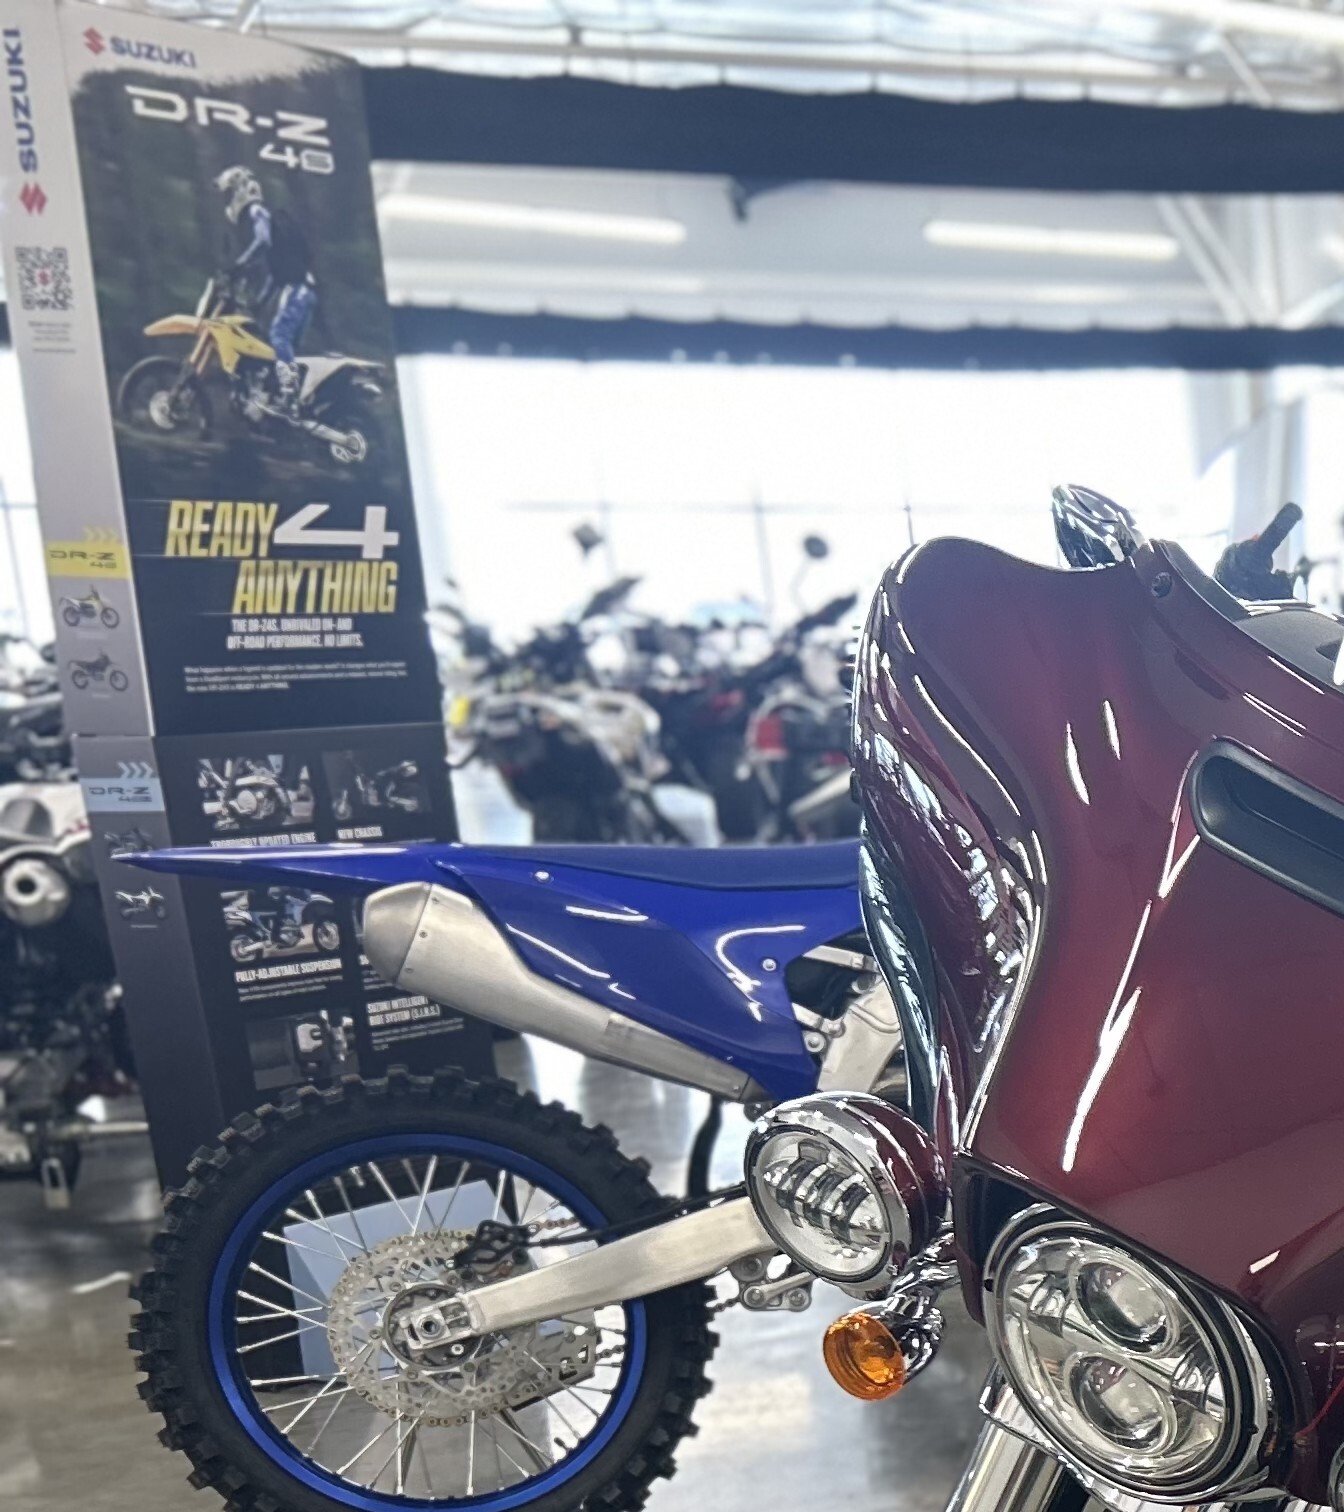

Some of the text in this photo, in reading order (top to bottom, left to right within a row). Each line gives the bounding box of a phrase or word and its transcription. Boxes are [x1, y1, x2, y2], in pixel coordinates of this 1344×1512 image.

[110, 36, 196, 68] SUZUKI
[2, 28, 39, 173] SUZUKI
[125, 85, 330, 146] DR-Z
[164, 500, 399, 559] READY 4
[231, 560, 398, 615] ANYTHING
